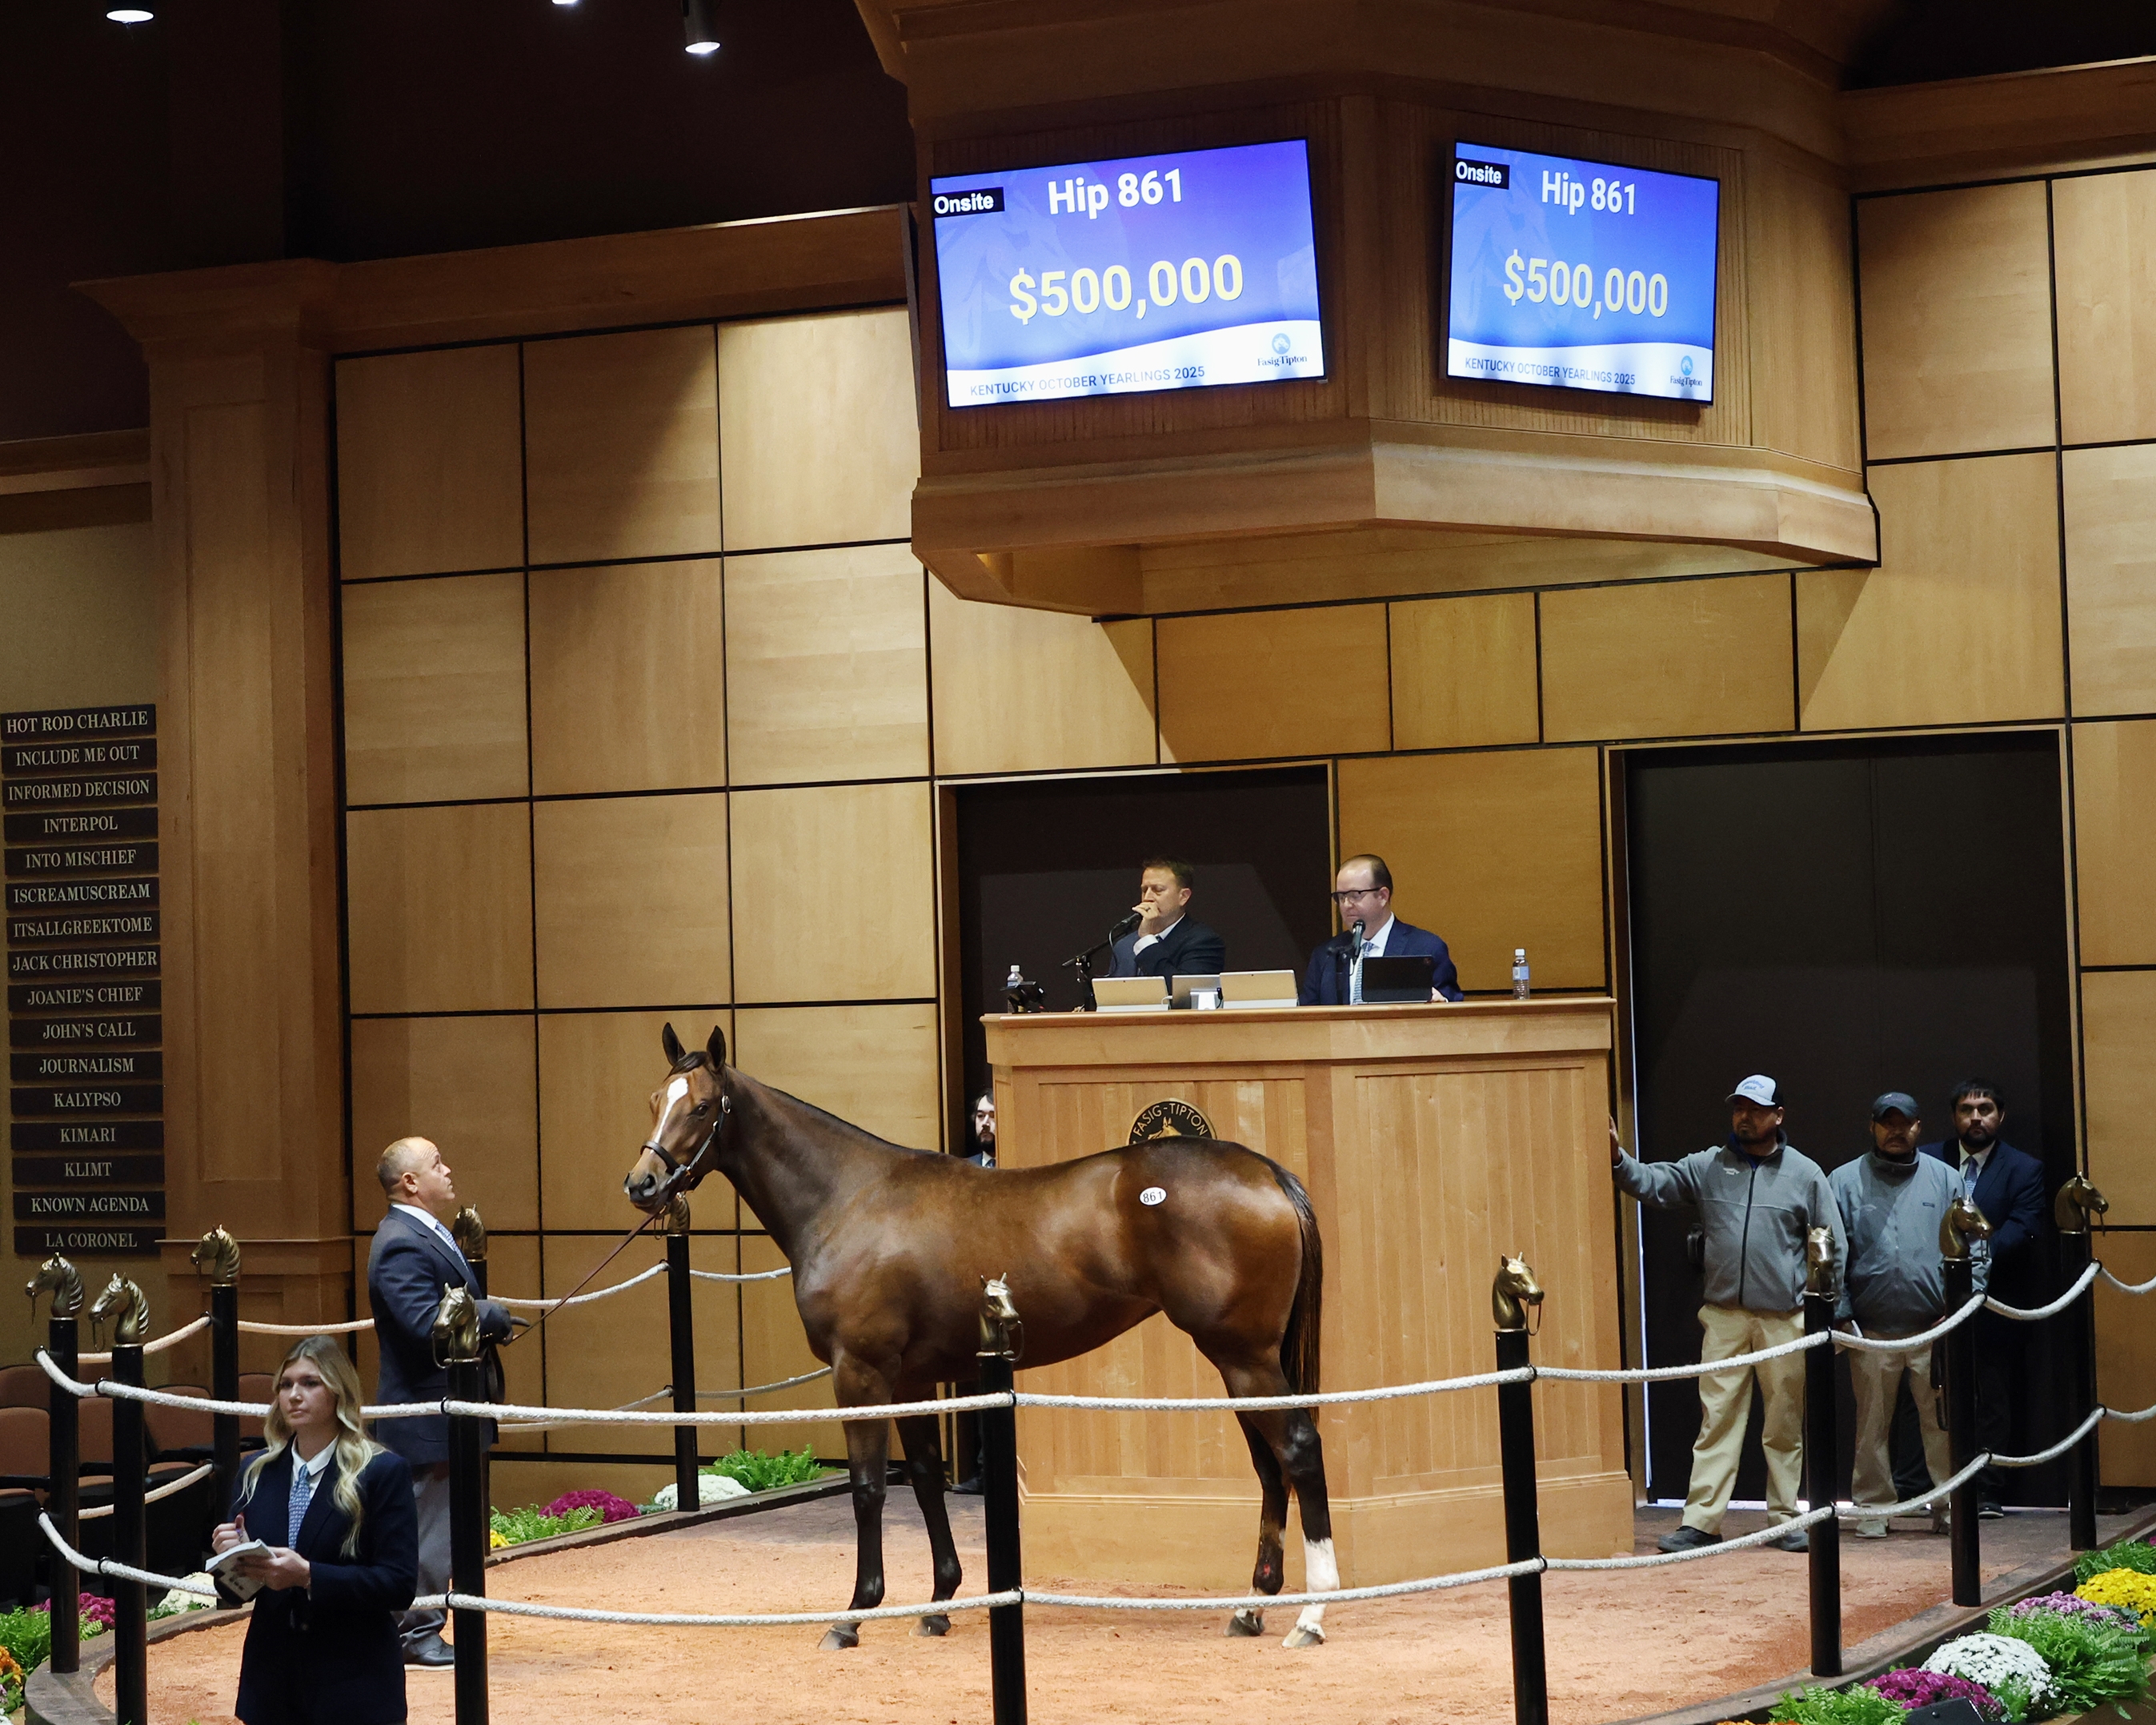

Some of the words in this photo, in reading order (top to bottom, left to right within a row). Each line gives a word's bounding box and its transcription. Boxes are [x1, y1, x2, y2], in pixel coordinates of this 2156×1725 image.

[1456, 161, 1501, 185] Onsite
[1048, 177, 1109, 219] Hip
[1118, 168, 1182, 208] 861
[1541, 170, 1585, 215] Hip
[1591, 178, 1635, 215] 861
[933, 192, 994, 215] Onsite
[1009, 254, 1244, 325] $500,000
[1503, 248, 1668, 320] $500,000
[970, 380, 1035, 397] KENTUCKY
[1039, 375, 1097, 391] OCTOBER
[1100, 369, 1171, 387] YEARLINGS
[1174, 366, 1205, 380] 2025
[1465, 358, 1515, 373] KENTUCKY
[1517, 362, 1560, 378] OCTOBER
[1562, 367, 1612, 383] YEARLINGS
[1614, 372, 1636, 385] 2025
[6, 718, 38, 733] HOT
[42, 716, 74, 732] ROD
[77, 711, 148, 729] CHARLIE
[16, 748, 80, 766] INCLUDE
[84, 747, 106, 762] ME
[110, 745, 139, 761] OUT
[9, 783, 81, 800] INFORMED
[85, 780, 150, 797] DECISION
[44, 816, 118, 833] INTERPOL
[26, 852, 61, 868] INTO
[66, 849, 136, 867] MISCHIEF
[14, 884, 150, 903] ISCREAMUSCREAM
[14, 917, 152, 937] ITSALLGREEKTOME
[13, 955, 50, 971] JACK
[52, 951, 158, 969] CHRISTOPHER
[27, 988, 94, 1005] JOANIE'S
[98, 987, 143, 1002] CHIEF
[42, 1023, 94, 1039] JOHN'S
[98, 1022, 136, 1037] CALL
[39, 1058, 135, 1073] JOURNALISM
[54, 1092, 121, 1107] KALYPSO
[1133, 1103, 1208, 1136] FASIG-TIPTON
[60, 1127, 116, 1143] KIMARI
[65, 1162, 112, 1177] KLIMT
[31, 1197, 86, 1212] KNOWN
[89, 1197, 150, 1212] AGENDA
[1143, 1191, 1164, 1203] 861
[46, 1233, 65, 1247] LA
[68, 1233, 138, 1247] CORONEL
